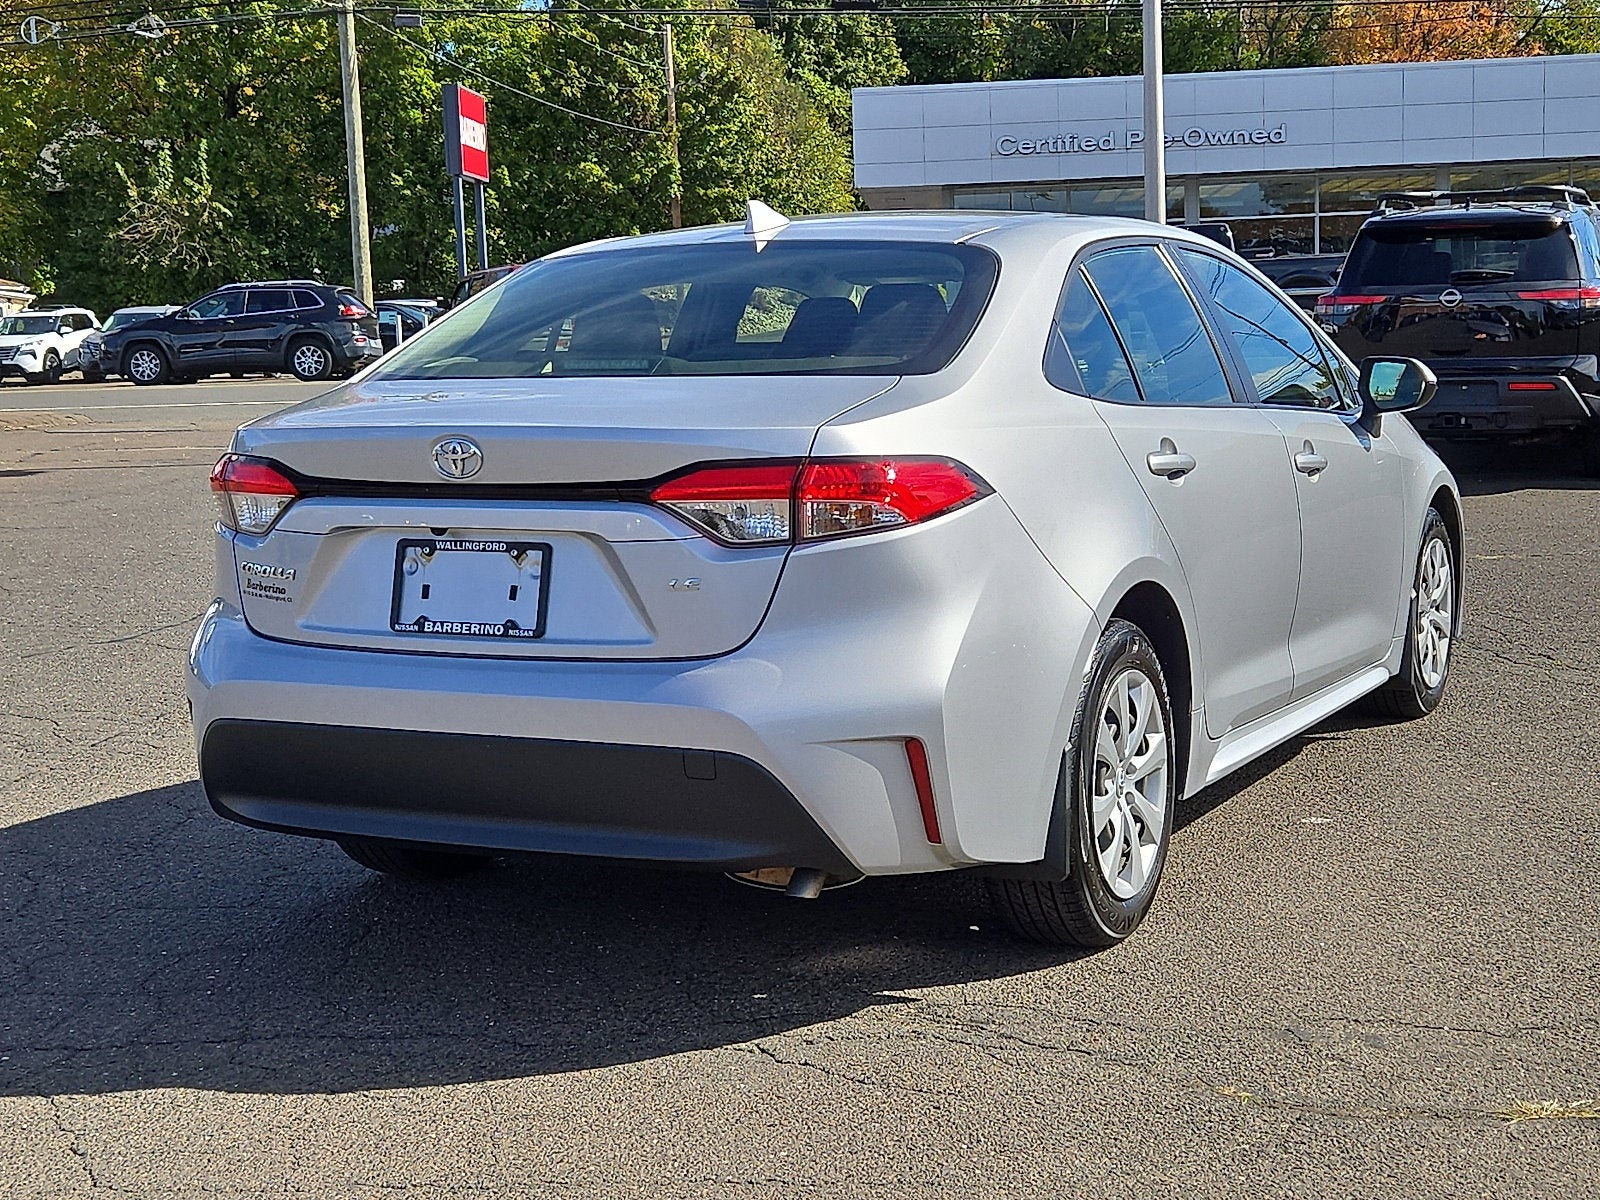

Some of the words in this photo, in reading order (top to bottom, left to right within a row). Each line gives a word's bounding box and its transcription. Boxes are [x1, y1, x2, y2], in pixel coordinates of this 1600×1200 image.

[996, 131, 1117, 156] Certified
[1126, 123, 1287, 151] Pe-Owned
[435, 540, 507, 551] WALLINGFORD
[241, 561, 296, 581] COROLLA
[246, 578, 287, 595] Barberino
[394, 623, 419, 632] NISSAN
[423, 621, 504, 635] BARBERINO
[508, 629, 534, 637] NISSAN
